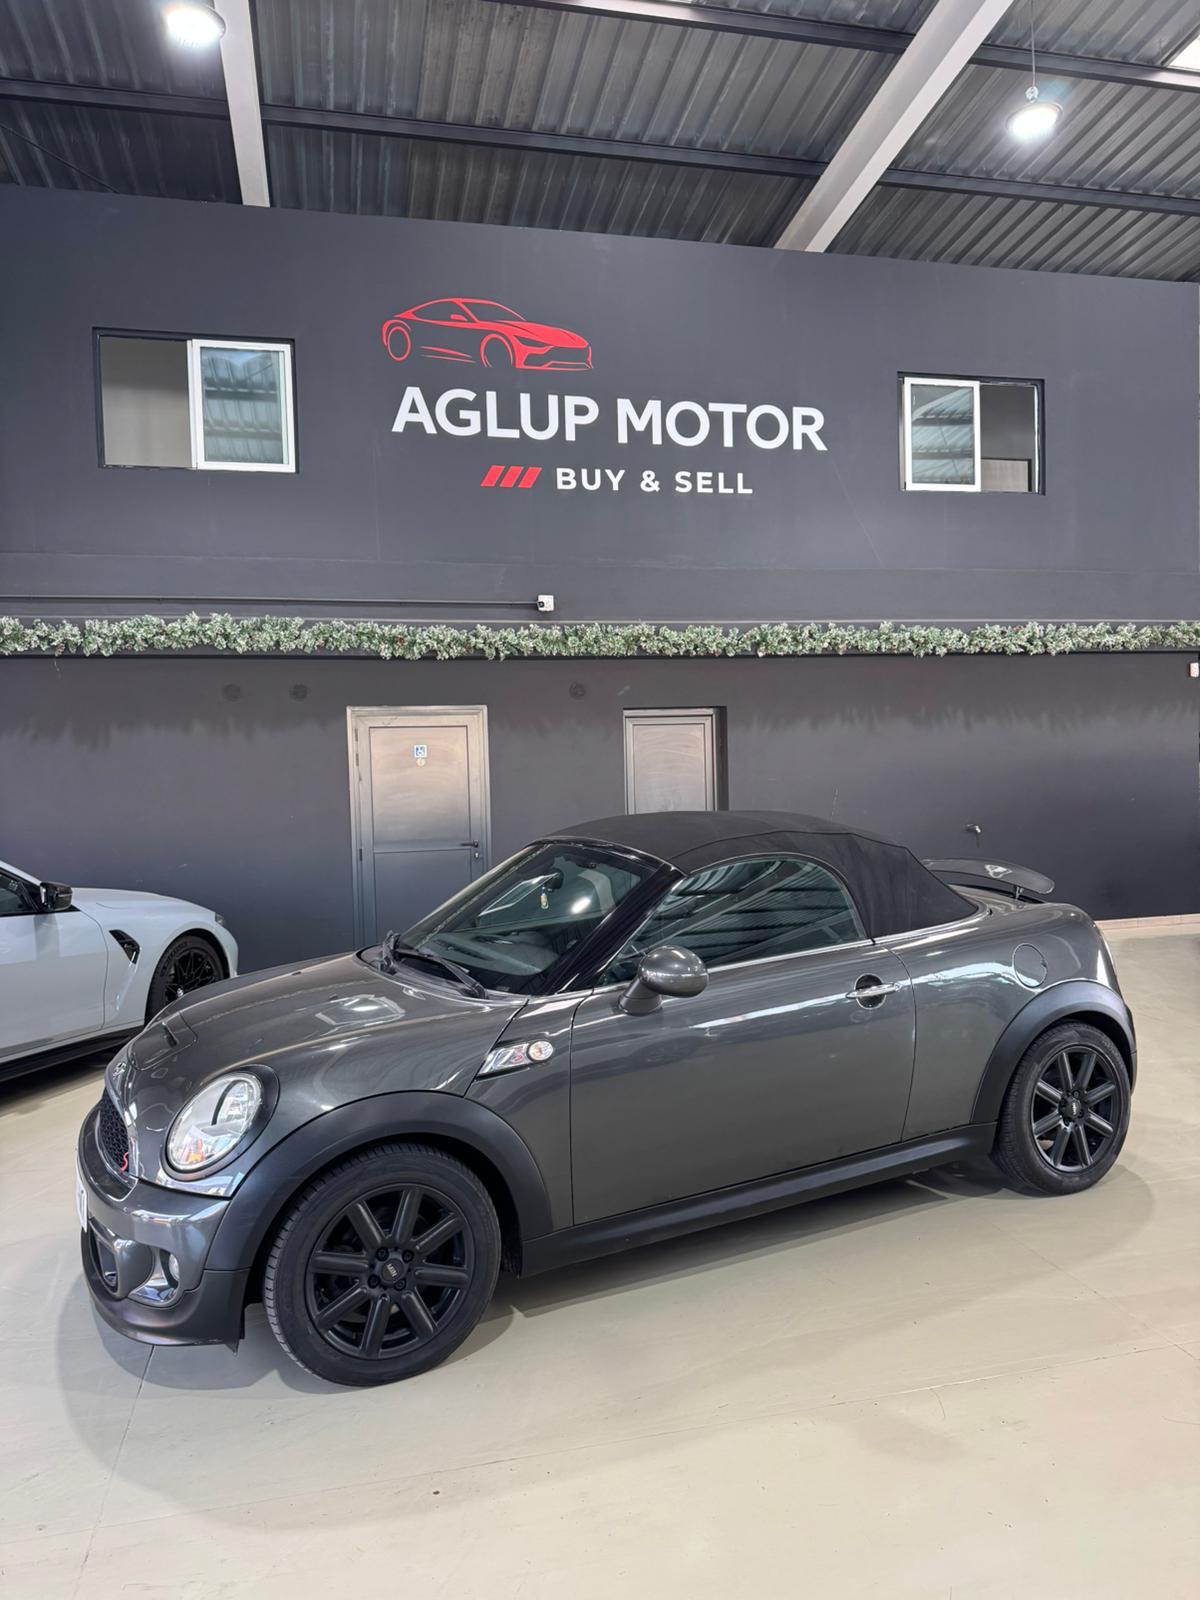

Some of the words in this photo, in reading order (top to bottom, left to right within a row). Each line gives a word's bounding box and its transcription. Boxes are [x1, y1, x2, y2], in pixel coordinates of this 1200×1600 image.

[392, 386, 600, 442] AGLUP
[617, 398, 829, 452] MOTOR
[557, 467, 626, 493] BUY
[640, 469, 661, 493] &
[675, 470, 754, 495] SELL
